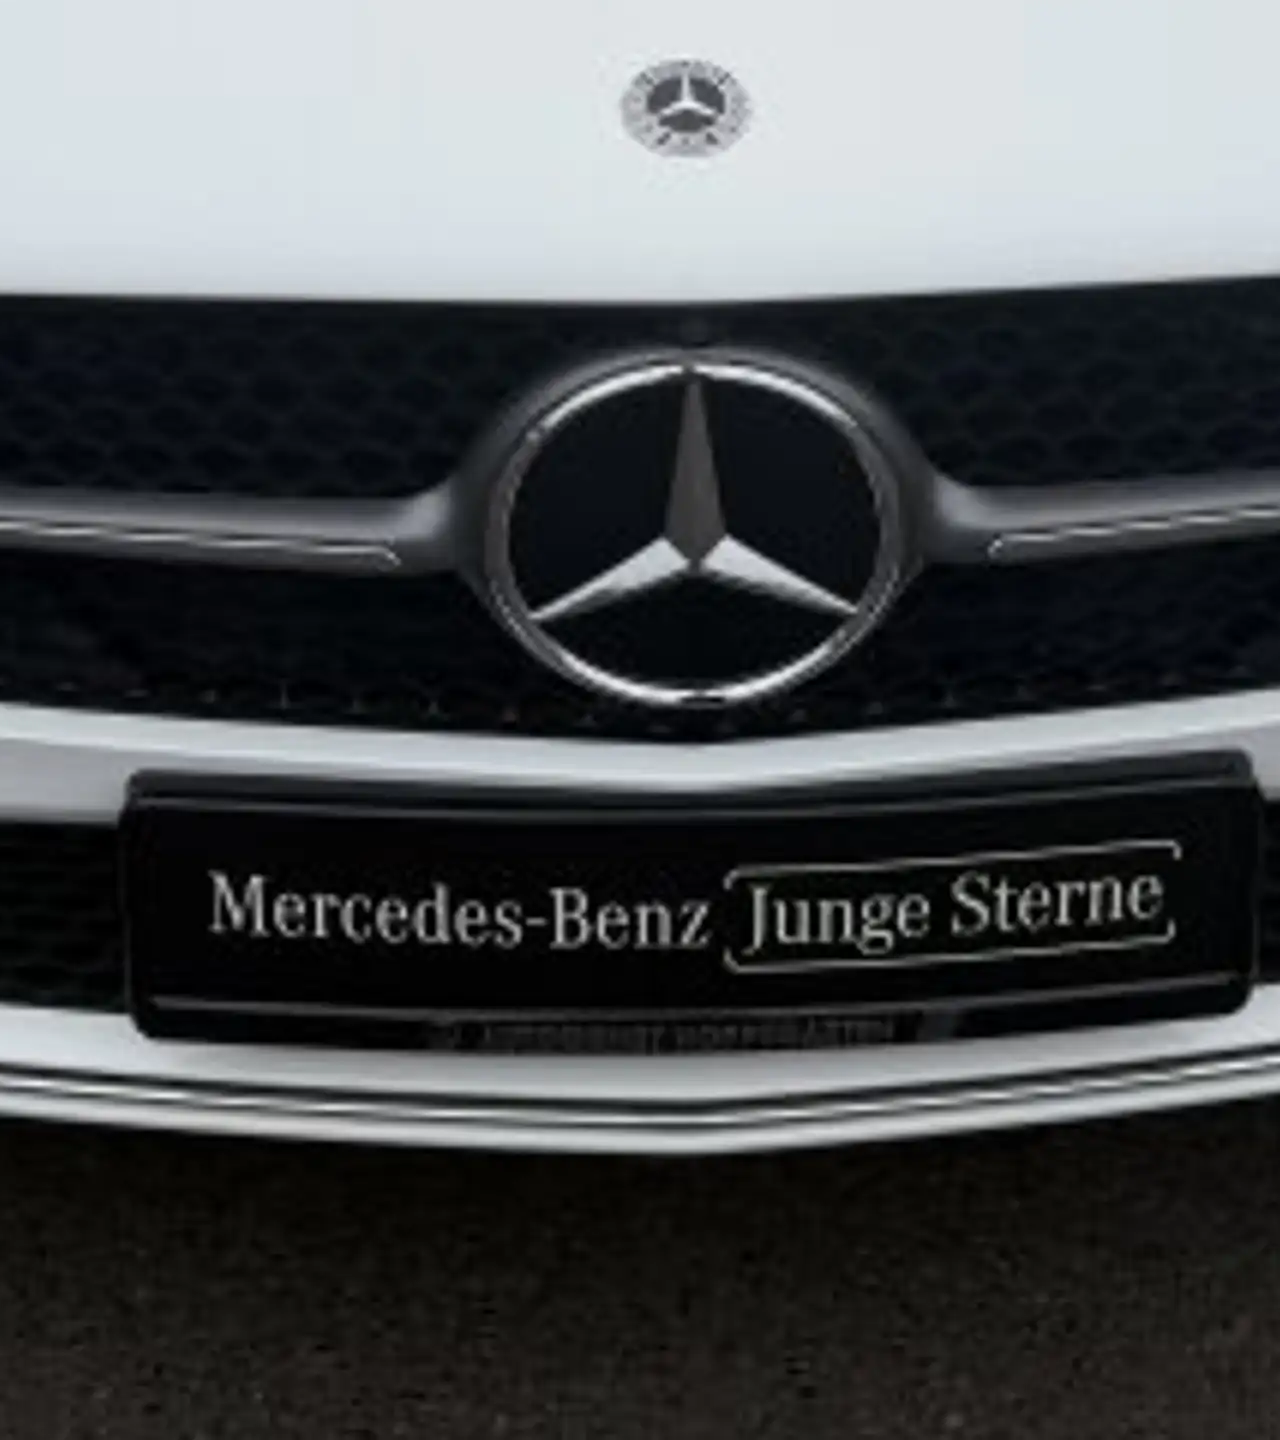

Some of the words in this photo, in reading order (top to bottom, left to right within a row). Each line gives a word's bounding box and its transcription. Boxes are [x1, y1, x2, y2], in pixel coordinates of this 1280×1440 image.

[208, 871, 711, 949] Mercedes-Benz
[743, 885, 932, 956] Junge
[949, 873, 1165, 935] Sterne
